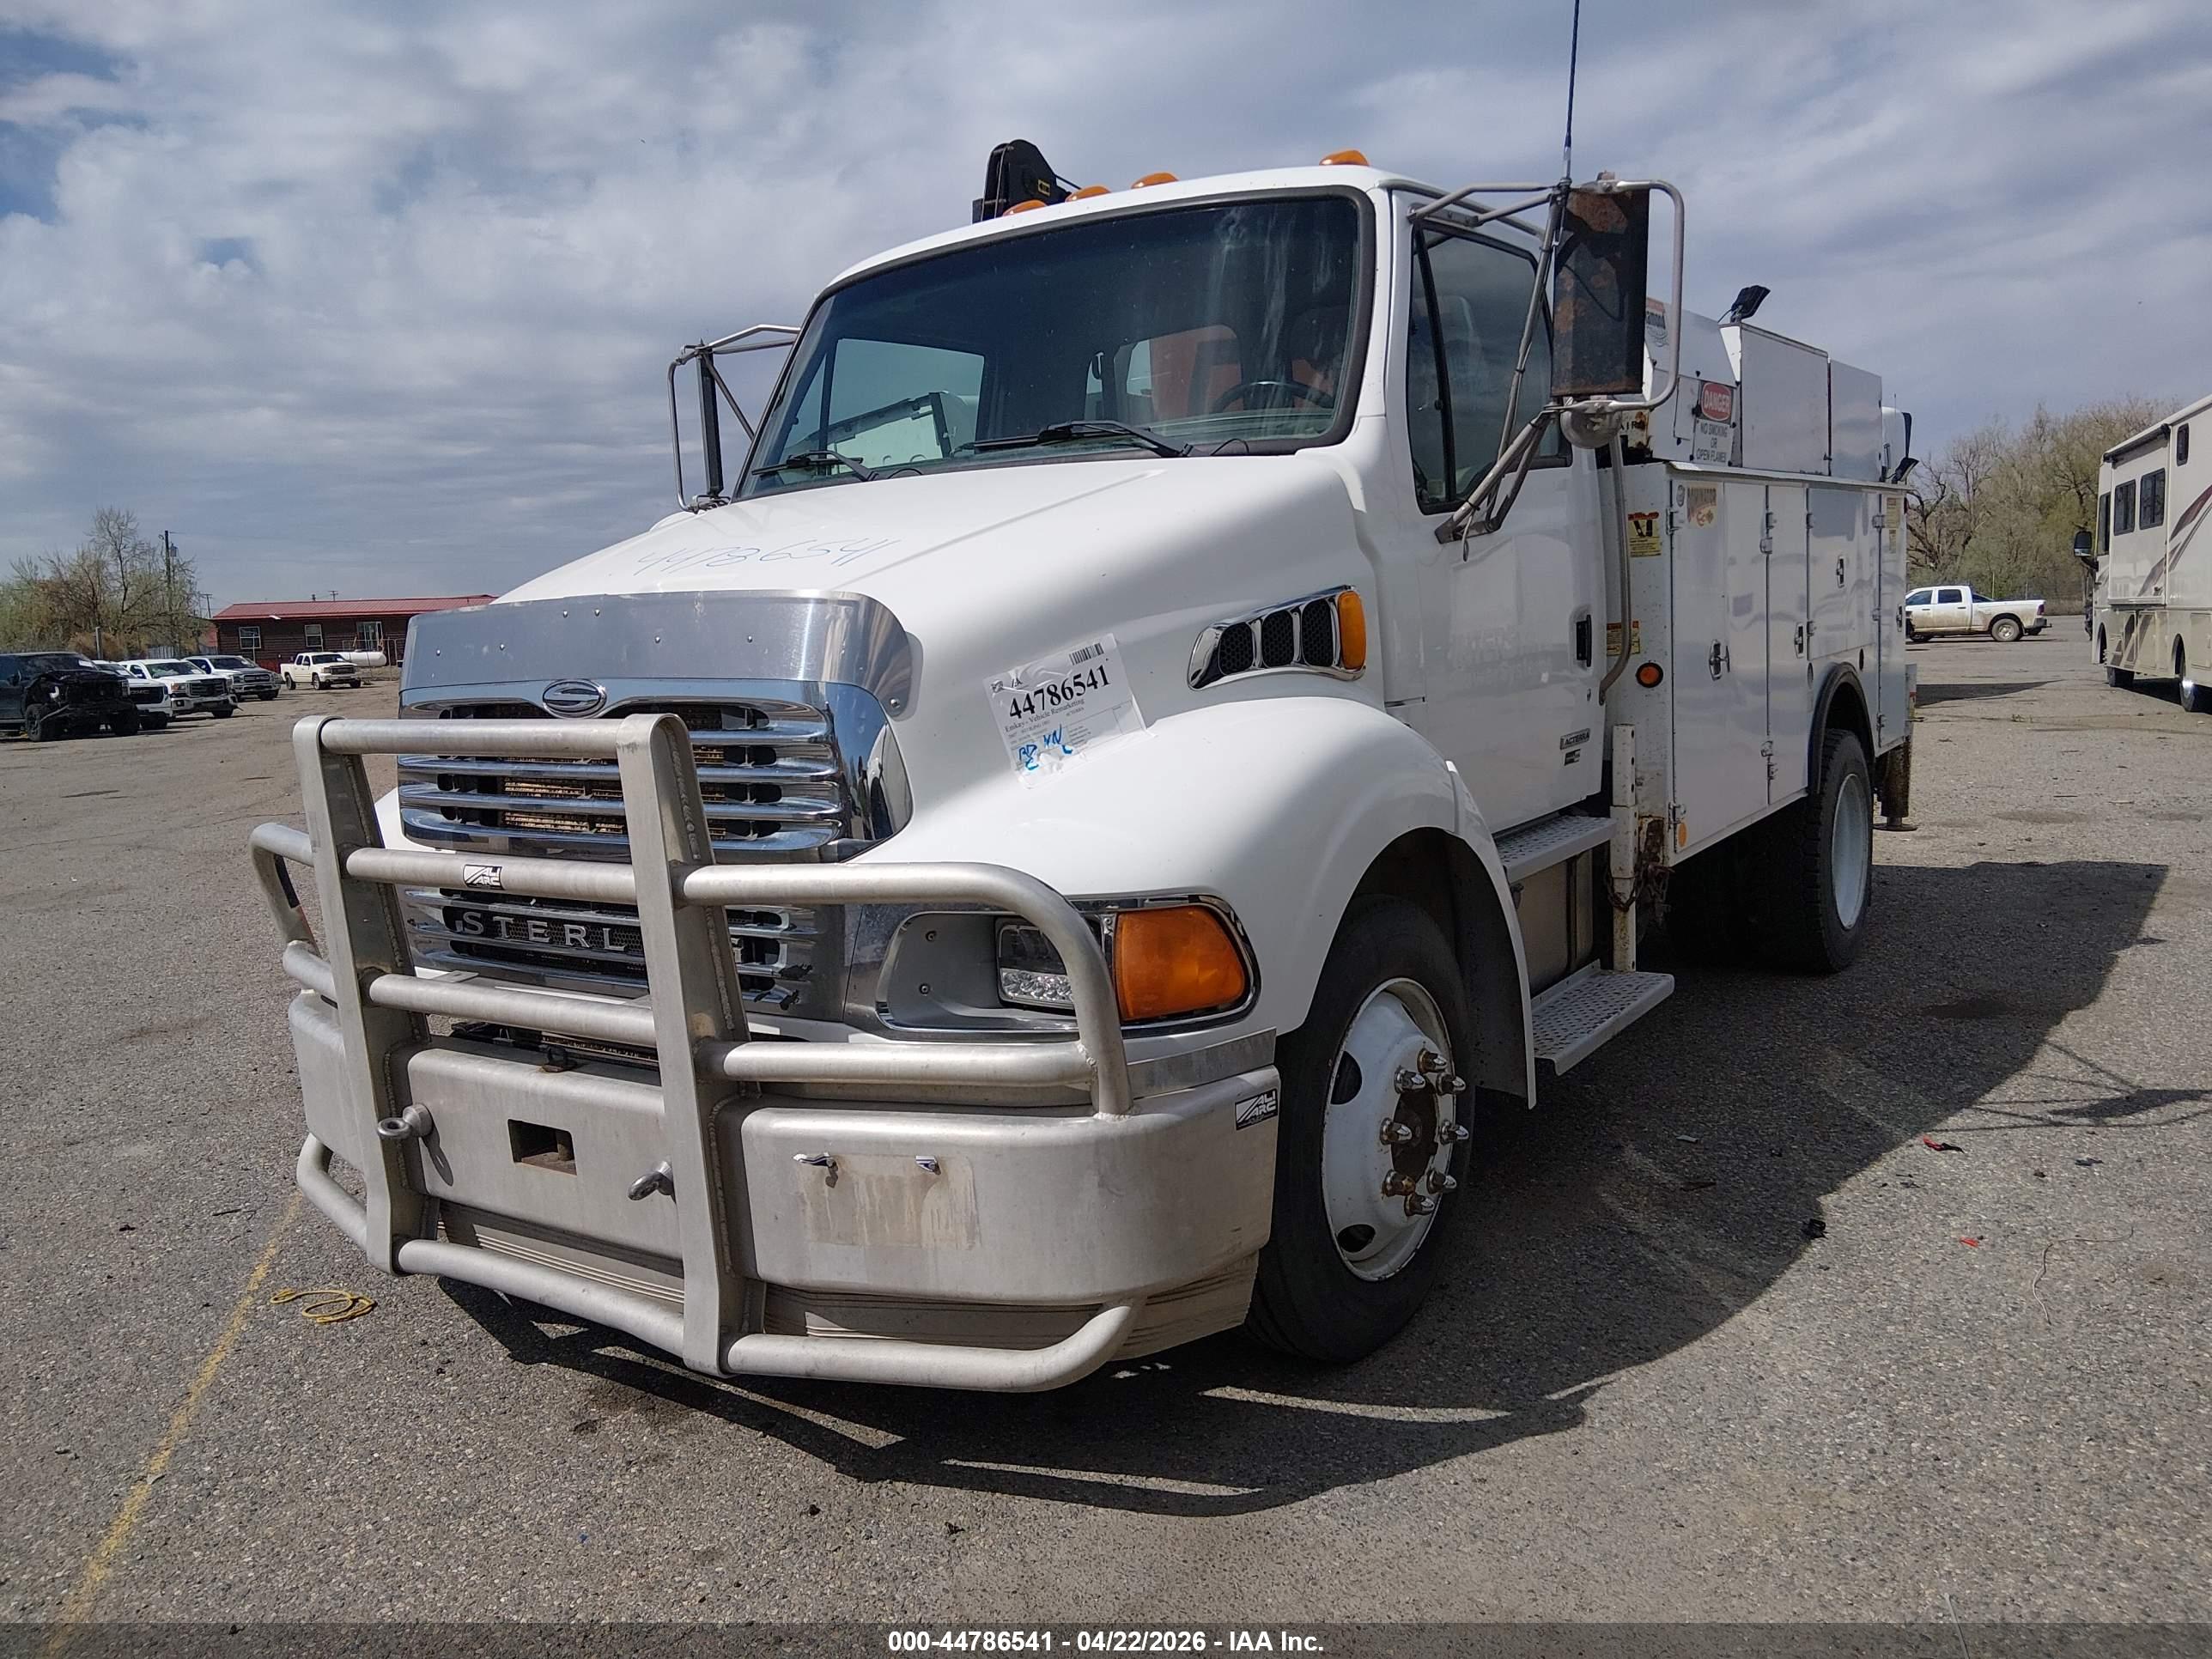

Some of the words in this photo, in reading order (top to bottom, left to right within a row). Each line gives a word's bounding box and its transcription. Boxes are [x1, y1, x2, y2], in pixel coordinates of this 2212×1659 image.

[1704, 391, 1730, 412] DANGER
[1700, 422, 1708, 434] NO
[1709, 423, 1728, 437] SMOKING
[1711, 437, 1717, 448] OR
[1696, 448, 1710, 460] OPEN
[1009, 665, 1111, 719] 44786541
[1029, 711, 1050, 724] Vehicle
[1051, 698, 1085, 715] Remarketing
[1565, 732, 1590, 745] ACTERRA
[473, 876, 501, 886] ARC
[1245, 1101, 1277, 1121] ARC
